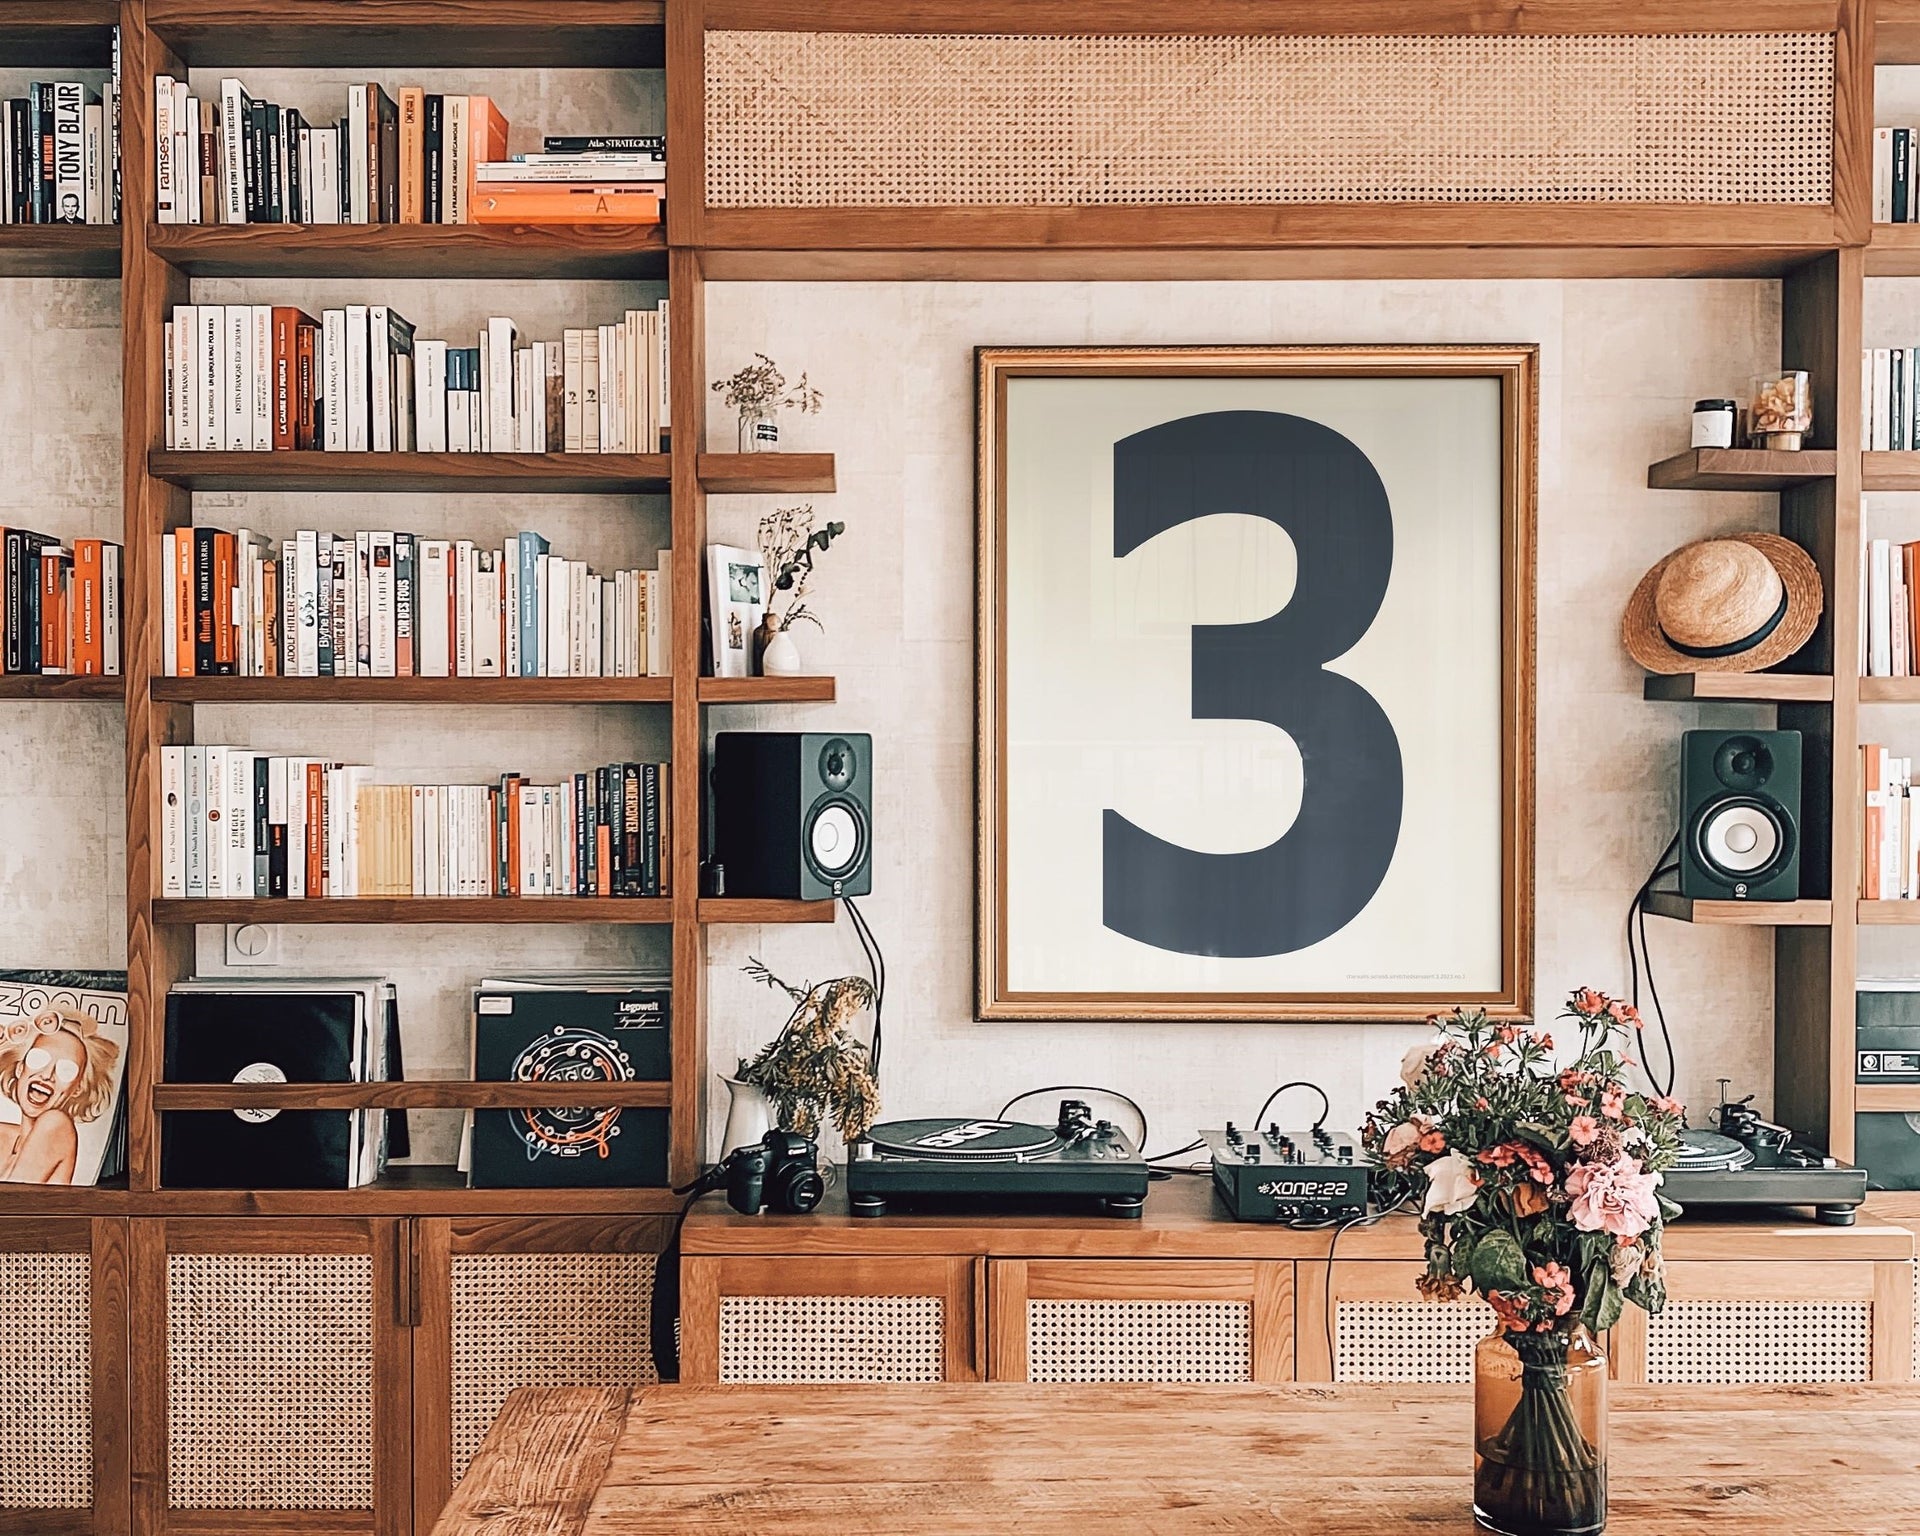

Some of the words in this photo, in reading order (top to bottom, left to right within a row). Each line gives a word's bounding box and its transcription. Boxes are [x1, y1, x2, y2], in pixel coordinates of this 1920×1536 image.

[58, 86, 80, 133] BLAIR
[58, 139, 80, 183] TONY
[160, 136, 170, 190] ramses
[452, 209, 459, 218] LA
[596, 196, 608, 213] A
[279, 359, 287, 386] PEUPLE
[279, 388, 287, 398] DU
[279, 399, 287, 424] CAUSE
[331, 418, 338, 426] LE
[279, 424, 287, 435] LA
[200, 541, 209, 569] HARRIS
[200, 571, 209, 602] ROBERT
[319, 580, 330, 617] Masters
[397, 579, 410, 601] FOUS
[287, 600, 295, 632] HITLER
[397, 602, 410, 619] DES
[85, 635, 91, 643] LA
[199, 609, 211, 643] Munich
[319, 618, 330, 648] Blythe
[287, 634, 295, 663] ADOLF
[1103, 411, 1402, 957] 3
[646, 767, 654, 807] OBAMA'S
[625, 778, 638, 832] UNDERCOVER
[646, 808, 654, 832] WARS
[231, 839, 239, 848] 12
[620, 1001, 659, 1014] Legowelt
[916, 1121, 1013, 1148] UDG
